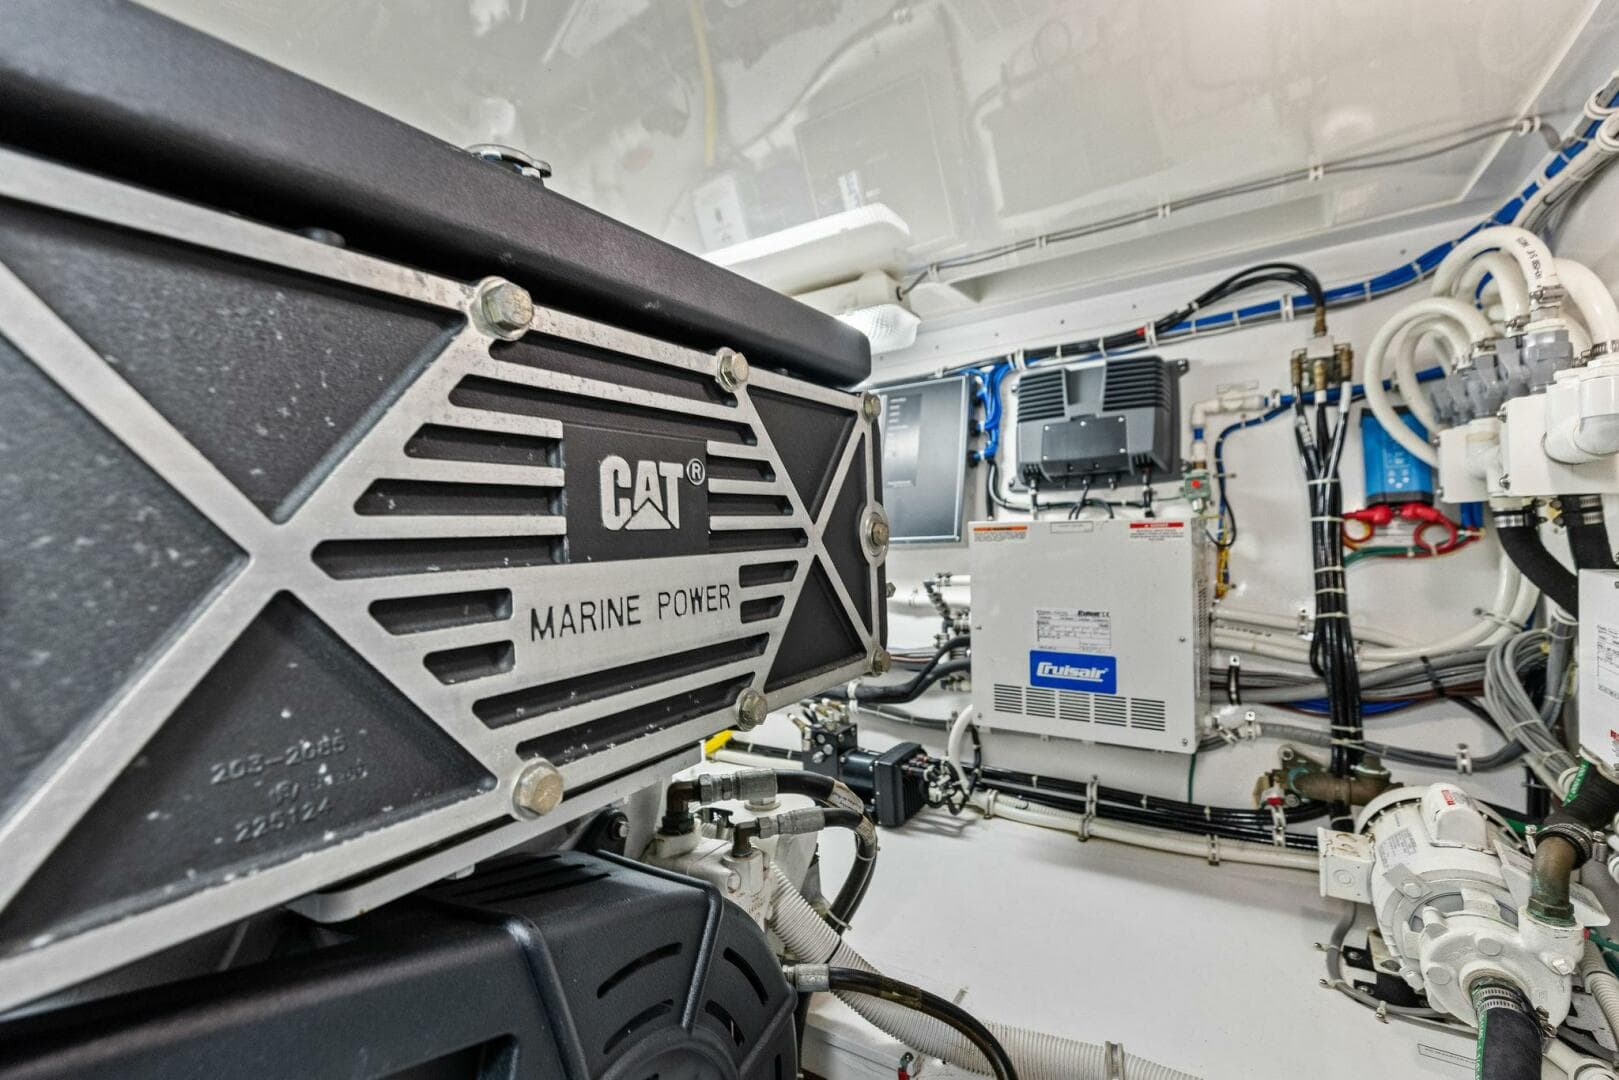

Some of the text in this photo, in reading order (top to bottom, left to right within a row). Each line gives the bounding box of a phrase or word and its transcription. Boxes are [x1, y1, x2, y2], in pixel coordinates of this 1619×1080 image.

[530, 583, 732, 643] MARINE POWER
[1036, 661, 1107, 682] Cruisair
